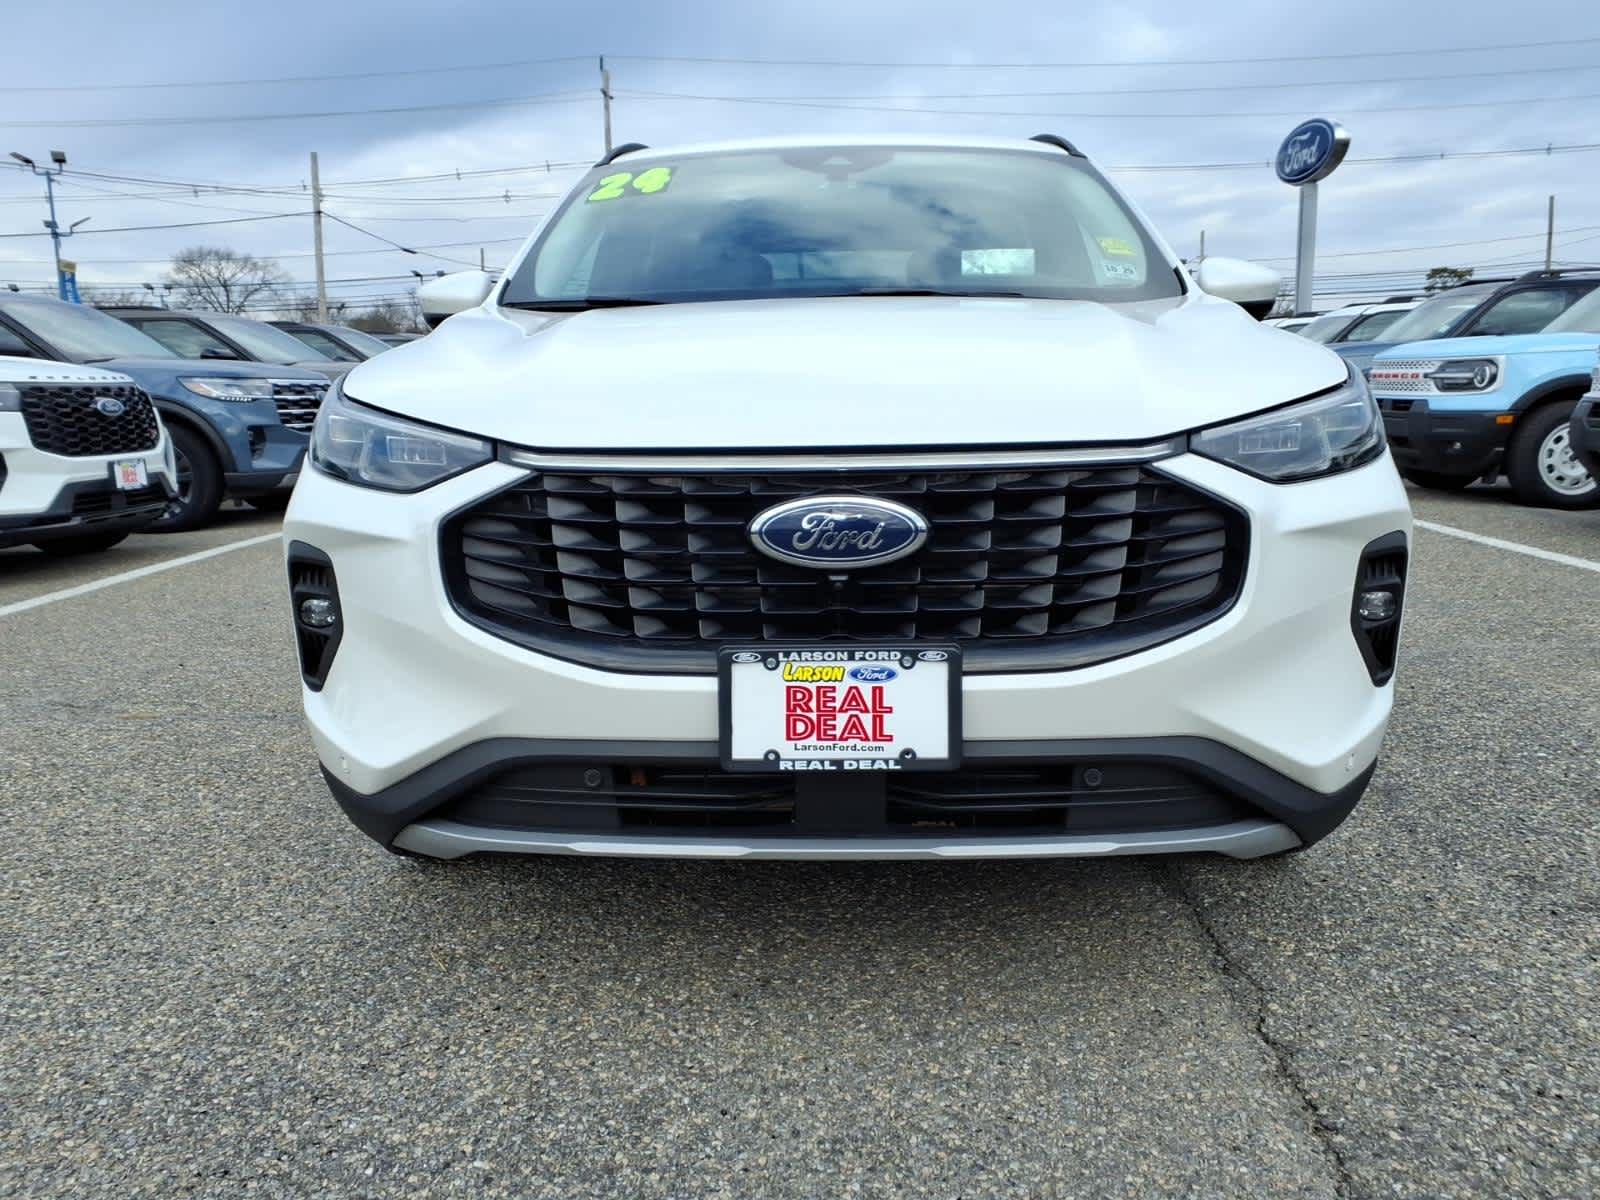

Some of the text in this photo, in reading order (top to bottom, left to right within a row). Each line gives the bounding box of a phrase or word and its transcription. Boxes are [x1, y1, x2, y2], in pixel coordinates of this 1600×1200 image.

[1283, 131, 1320, 174] Ford
[588, 167, 672, 201] 24
[792, 512, 885, 550] Ford
[778, 651, 902, 662] LARSON FORD
[857, 666, 890, 681] Ford
[785, 685, 894, 713] REAL
[785, 714, 894, 742] DEAL
[794, 743, 885, 752] LarsonFord.com
[779, 759, 902, 770] REAL DEAL
